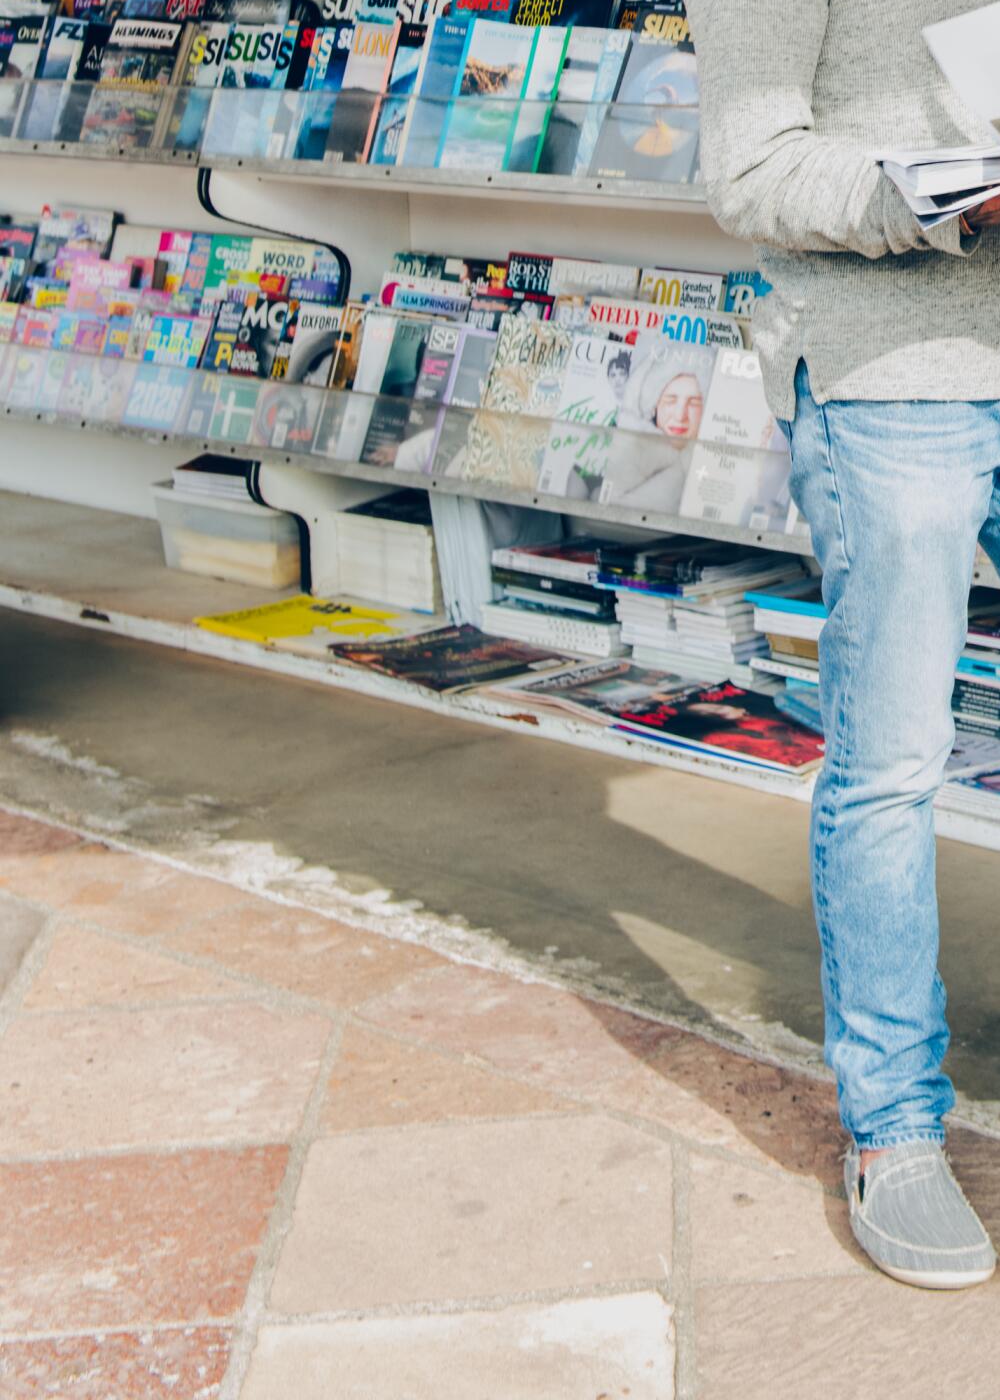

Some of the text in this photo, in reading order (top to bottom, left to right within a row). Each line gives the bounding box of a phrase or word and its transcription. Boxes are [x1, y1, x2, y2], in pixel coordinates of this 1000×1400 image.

[114, 24, 175, 41] HEMMINGS
[263, 251, 305, 268] WORD
[682, 280, 713, 294] Greatest
[420, 297, 455, 312] SPRINGS
[588, 300, 640, 327] STEELY
[301, 315, 339, 329] OXFORD
